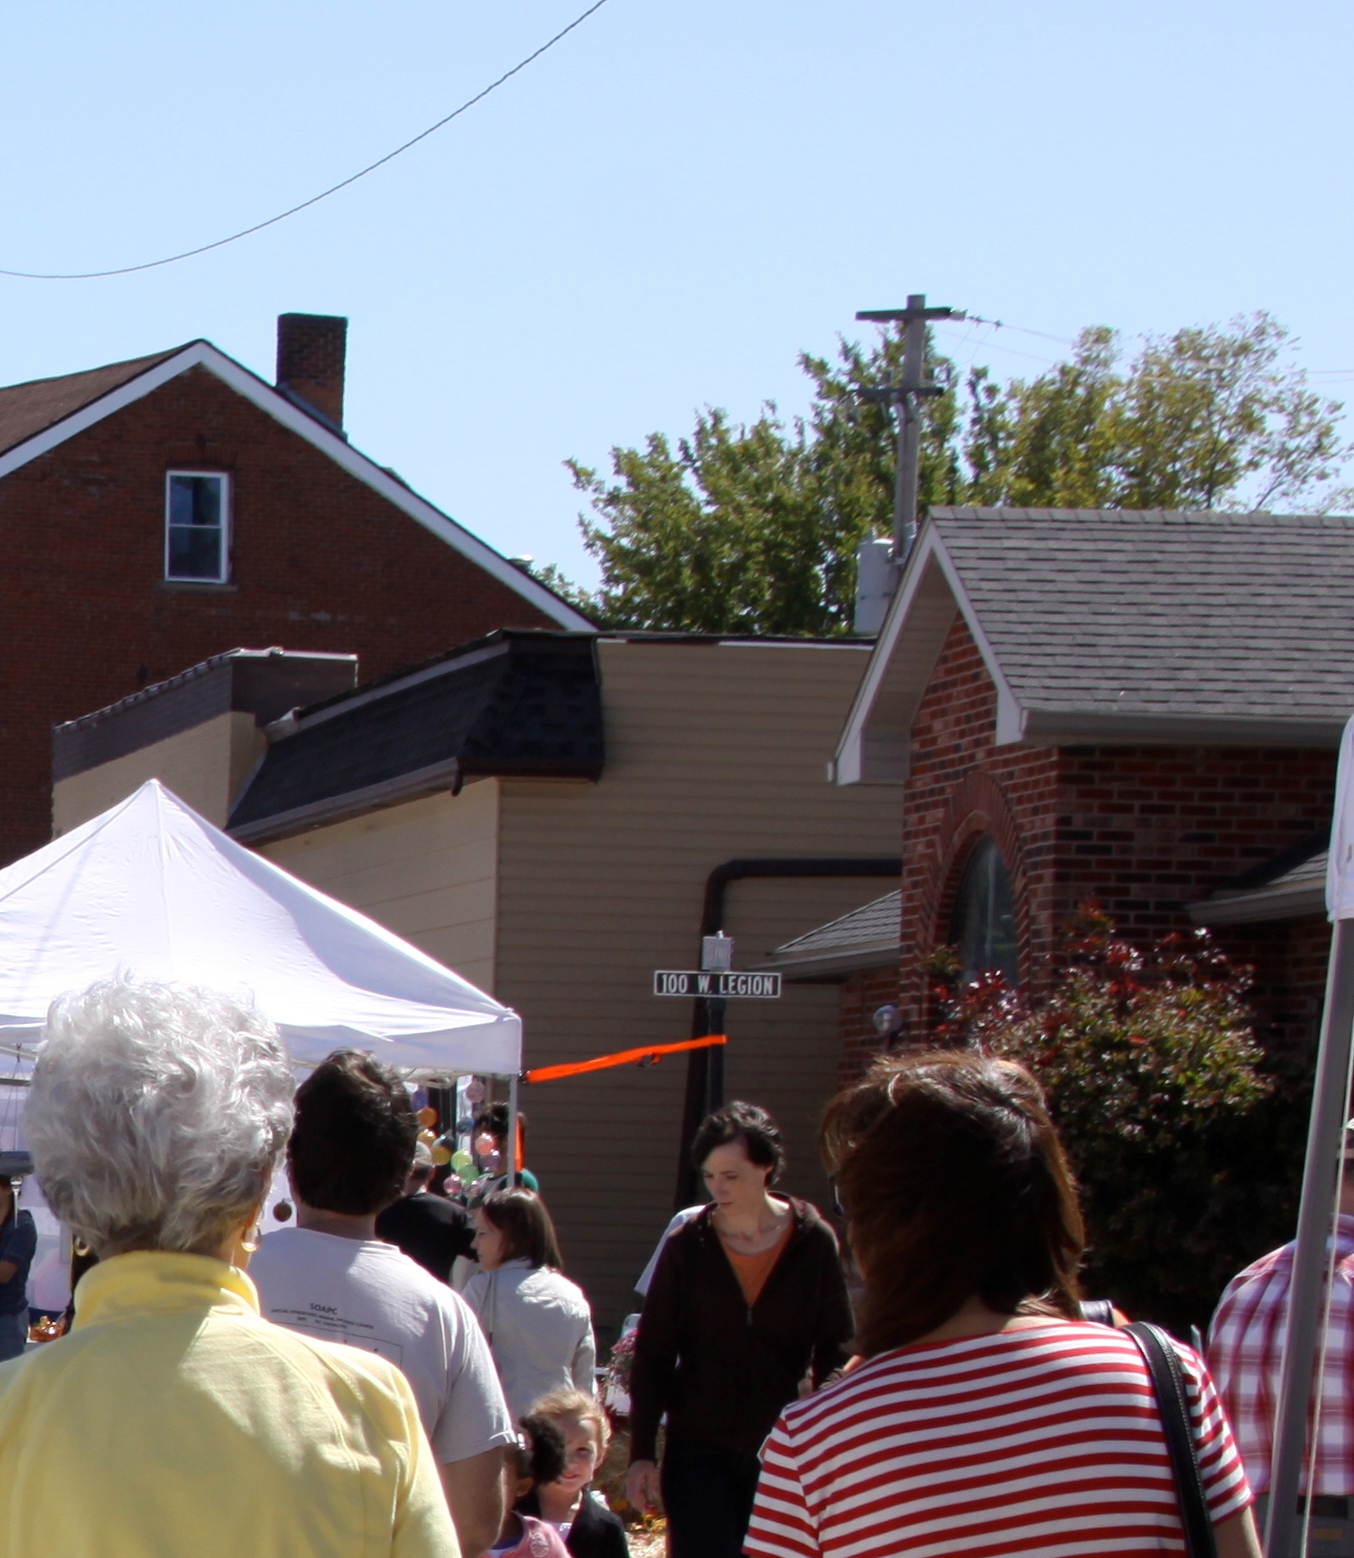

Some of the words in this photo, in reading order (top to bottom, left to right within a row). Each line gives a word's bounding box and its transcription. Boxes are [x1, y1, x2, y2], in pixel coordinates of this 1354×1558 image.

[662, 974, 688, 994] 100
[698, 975, 713, 994] W.
[719, 975, 773, 995] LEGION
[309, 1302, 339, 1315] SOAPC
